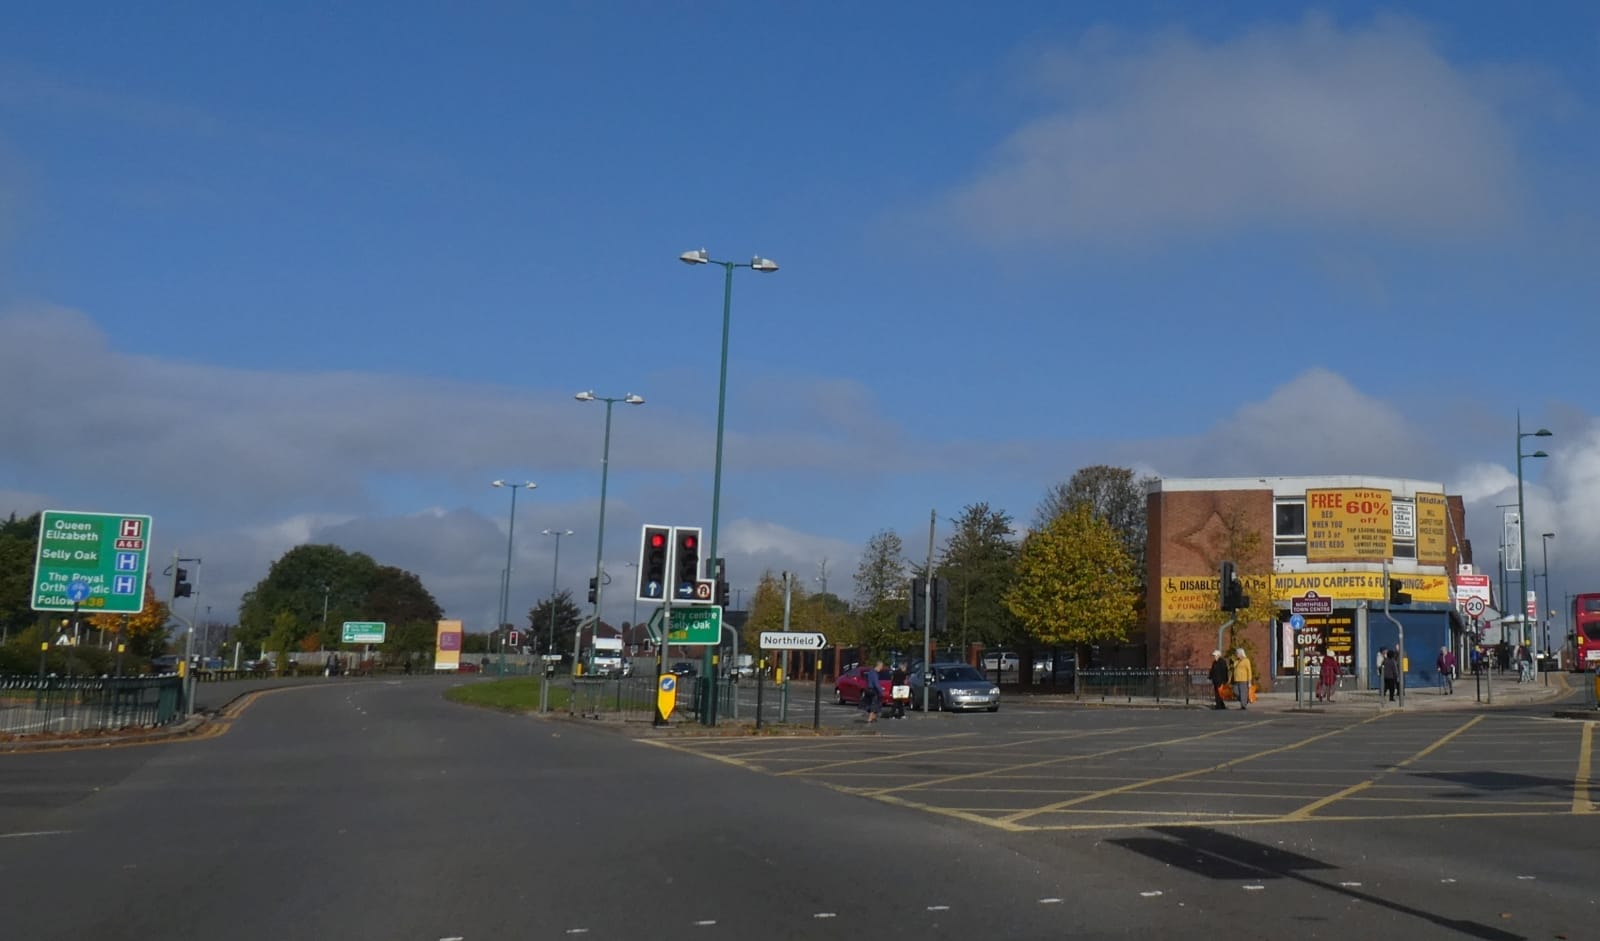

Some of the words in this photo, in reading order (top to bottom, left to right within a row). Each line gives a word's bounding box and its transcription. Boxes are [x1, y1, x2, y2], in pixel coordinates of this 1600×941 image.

[1311, 493, 1343, 509] FREE
[1346, 501, 1389, 516] 60%
[55, 519, 92, 531] Queen
[123, 520, 139, 536] H
[1312, 520, 1329, 528] WHEN
[1331, 520, 1343, 528] YOU
[45, 529, 99, 542] Elizabeth
[42, 549, 71, 561] Selly
[74, 550, 98, 561] Oak
[120, 554, 135, 570] H
[48, 571, 69, 582] The
[72, 573, 104, 584] Royal
[1275, 576, 1320, 590] MIDLAND
[1323, 576, 1365, 588] CARPETS
[1367, 577, 1374, 588] &
[40, 582, 110, 595] Orthdic
[117, 577, 132, 593] H
[37, 595, 75, 606] Follow
[1468, 601, 1482, 611] 20
[688, 611, 718, 620] centre
[692, 620, 711, 630] Oak
[764, 636, 814, 645] Northfield
[1297, 634, 1322, 645] 60%
